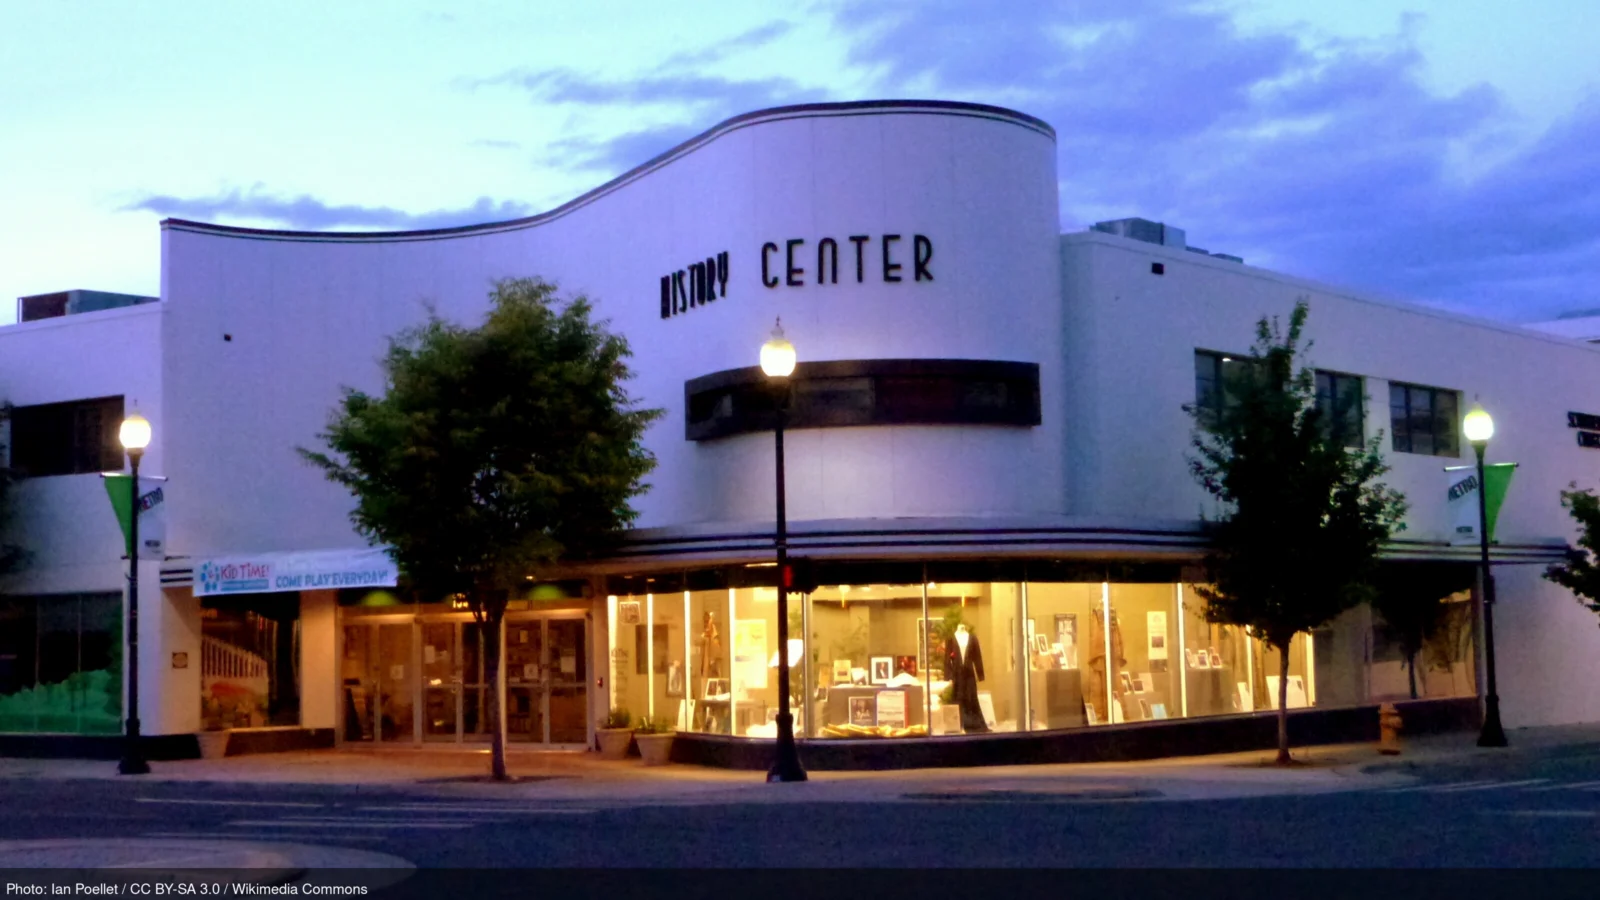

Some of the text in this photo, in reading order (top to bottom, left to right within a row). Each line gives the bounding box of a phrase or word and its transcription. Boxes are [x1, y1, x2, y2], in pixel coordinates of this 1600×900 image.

[660, 234, 934, 319] HISTORY CENTER
[276, 575, 301, 588] COME
[305, 573, 331, 586] PLAY
